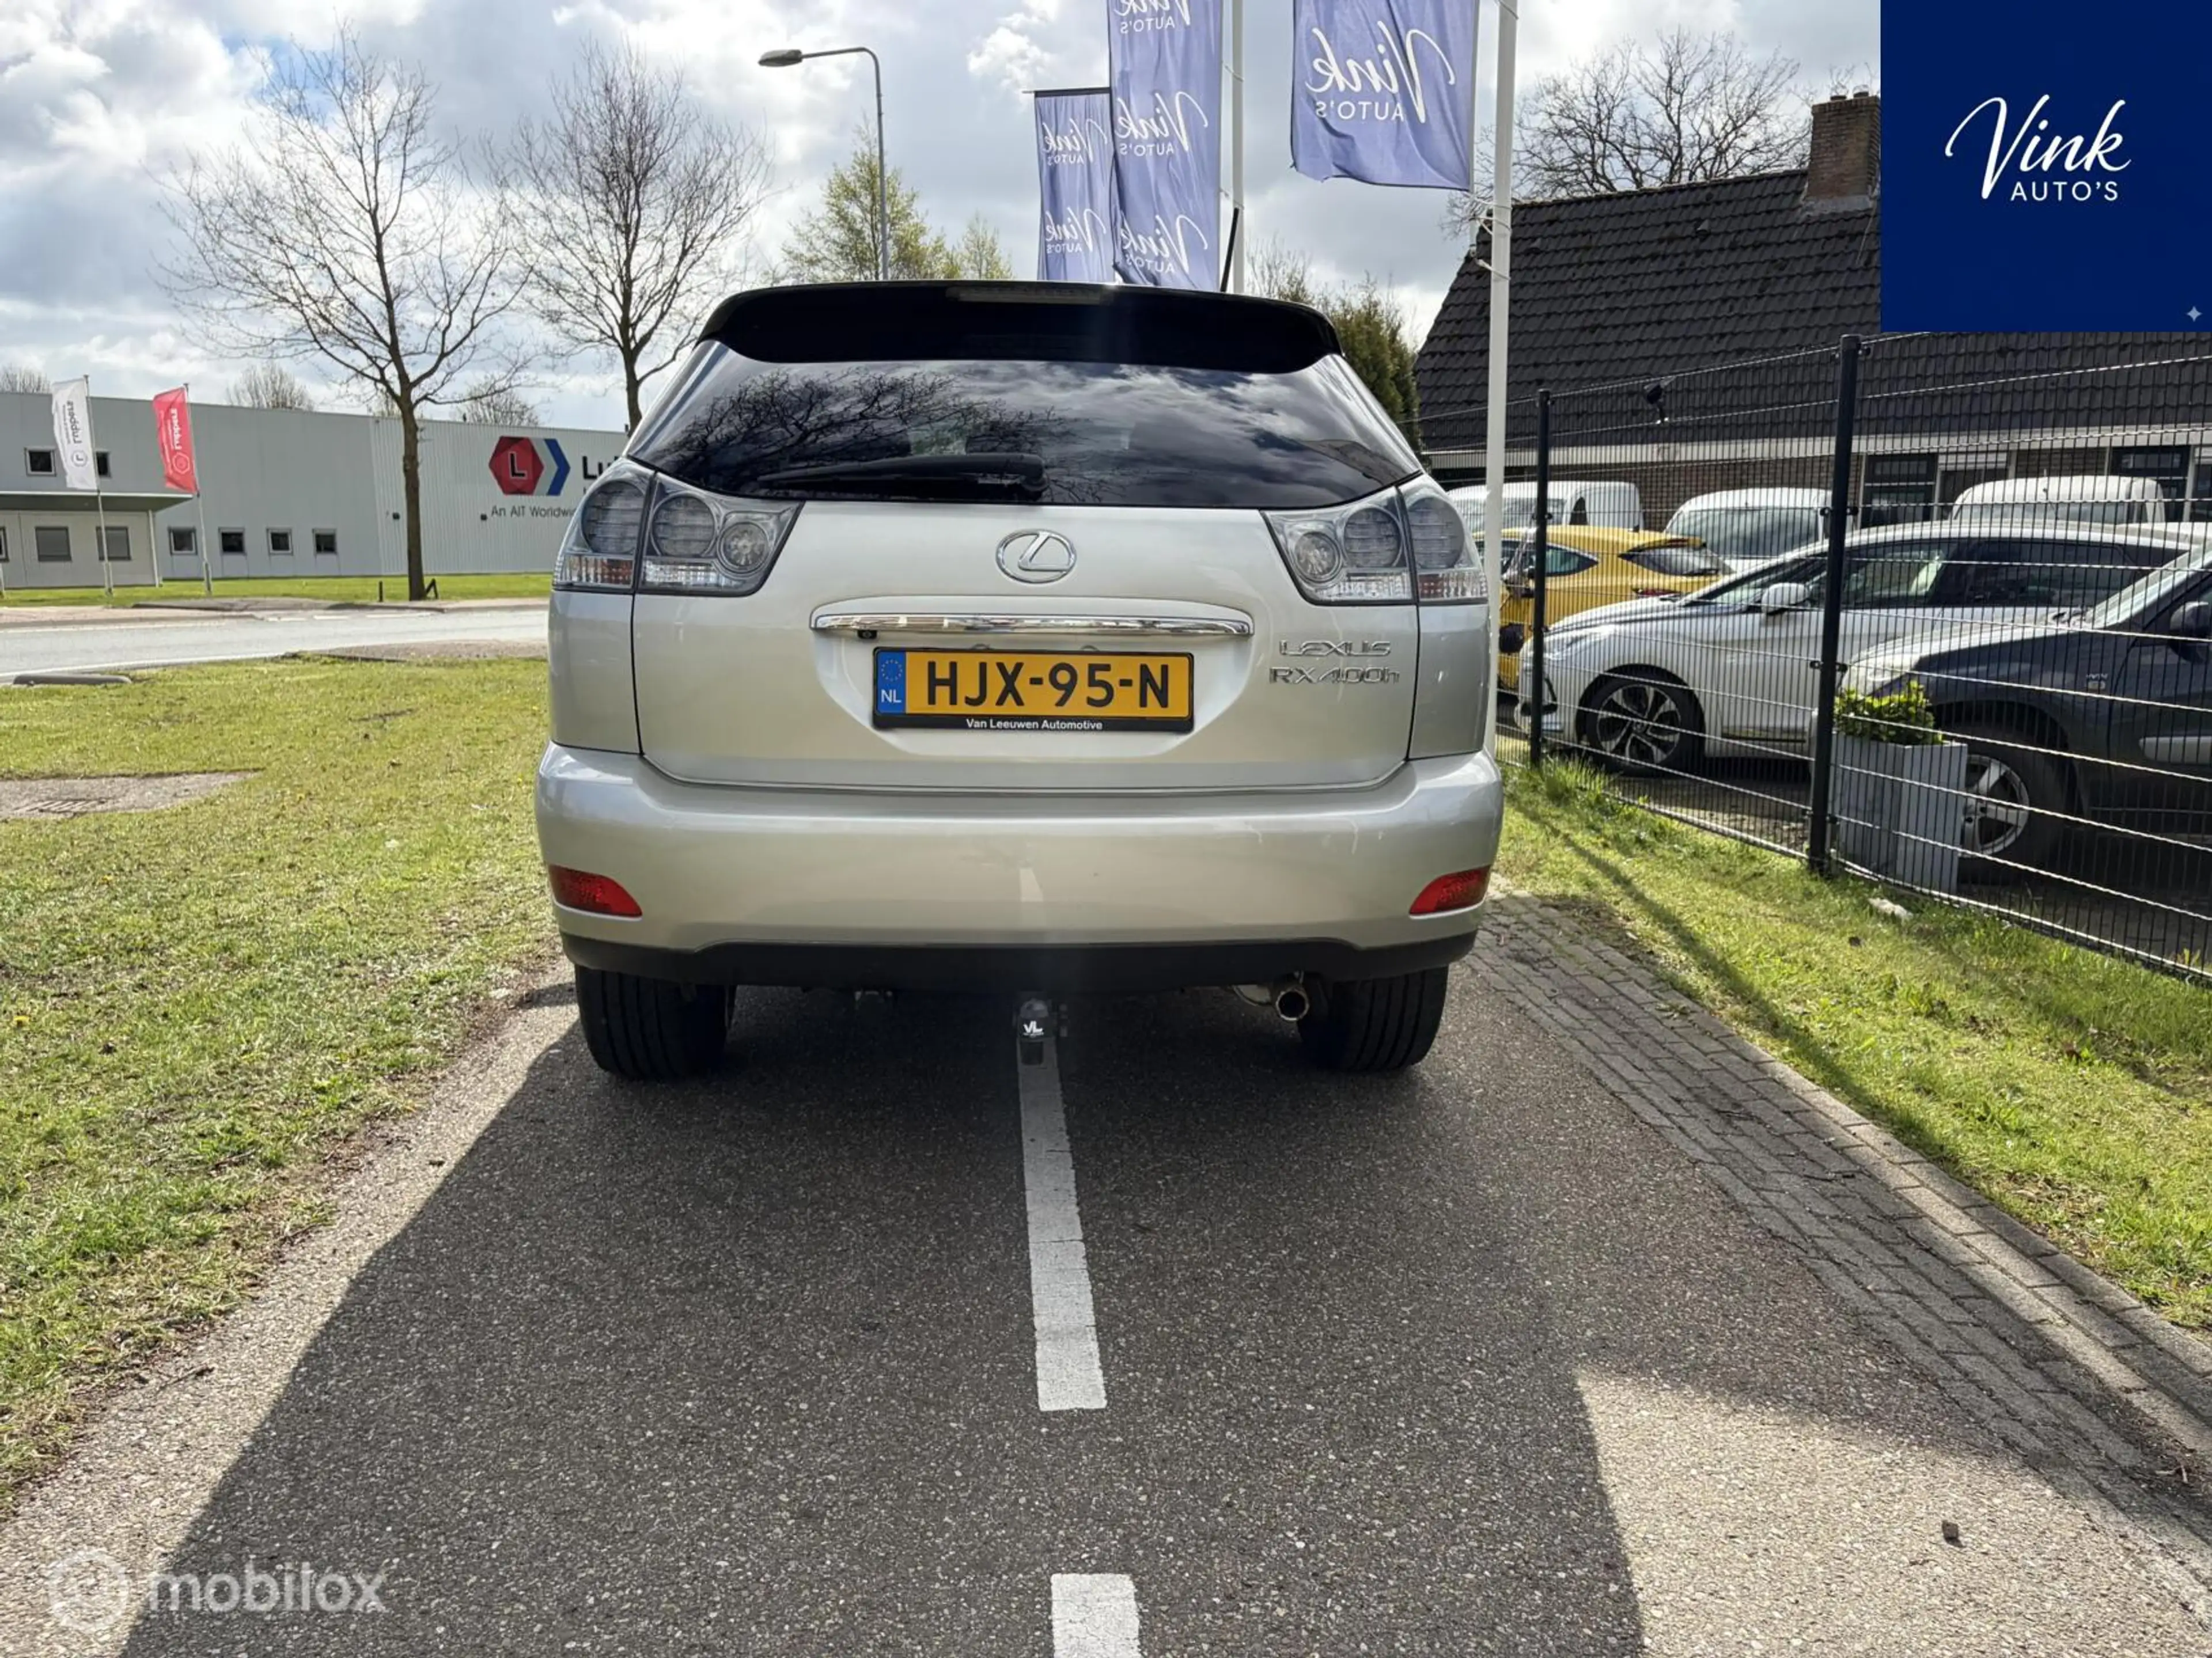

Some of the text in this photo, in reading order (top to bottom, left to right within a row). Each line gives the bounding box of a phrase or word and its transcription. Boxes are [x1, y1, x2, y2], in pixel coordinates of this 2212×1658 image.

[491, 506, 506, 517] An
[1279, 640, 1392, 657] LEXUS
[927, 661, 1169, 709] HJX-95-N
[881, 690, 902, 703] NL
[966, 718, 1103, 730] Van Leeuwen Automotive
